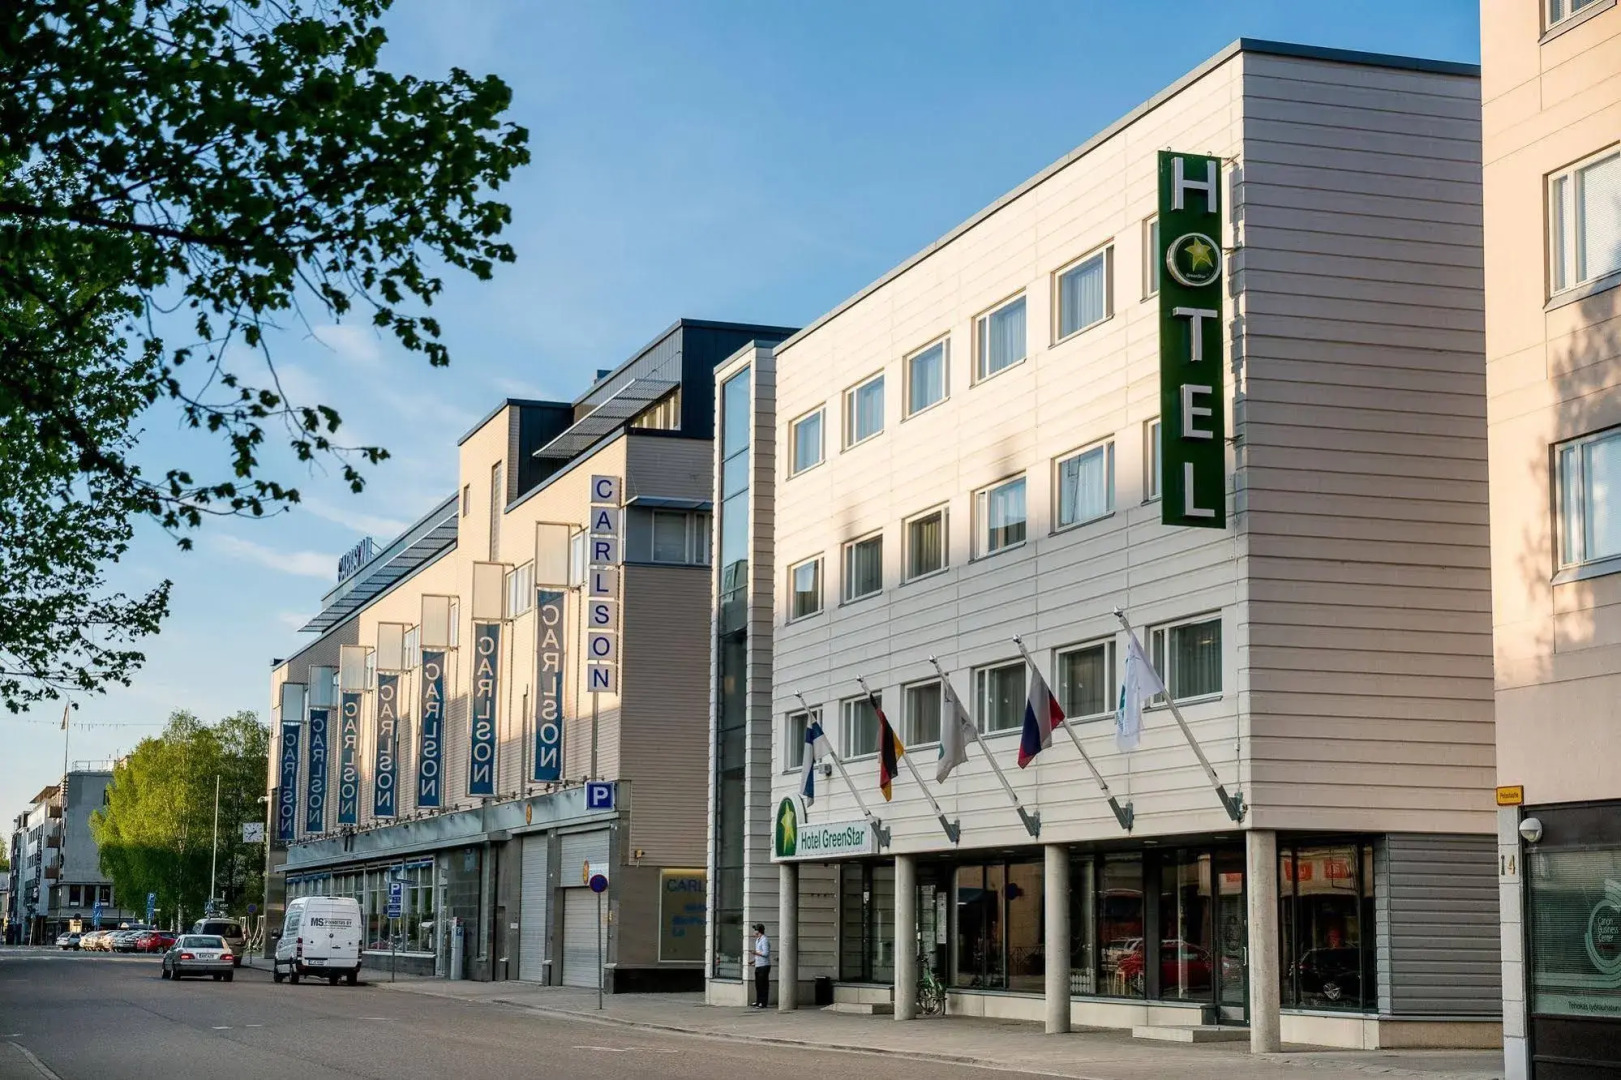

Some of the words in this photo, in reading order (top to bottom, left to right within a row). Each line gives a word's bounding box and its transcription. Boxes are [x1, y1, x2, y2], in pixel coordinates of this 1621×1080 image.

[1166, 156, 1222, 518] HOTEL
[592, 479, 613, 688] CARLSON
[593, 786, 609, 805] P
[801, 830, 821, 850] Hotel
[822, 826, 865, 848] GreenStar
[1501, 854, 1516, 876] 14
[391, 883, 400, 895] P
[311, 917, 324, 926] MS
